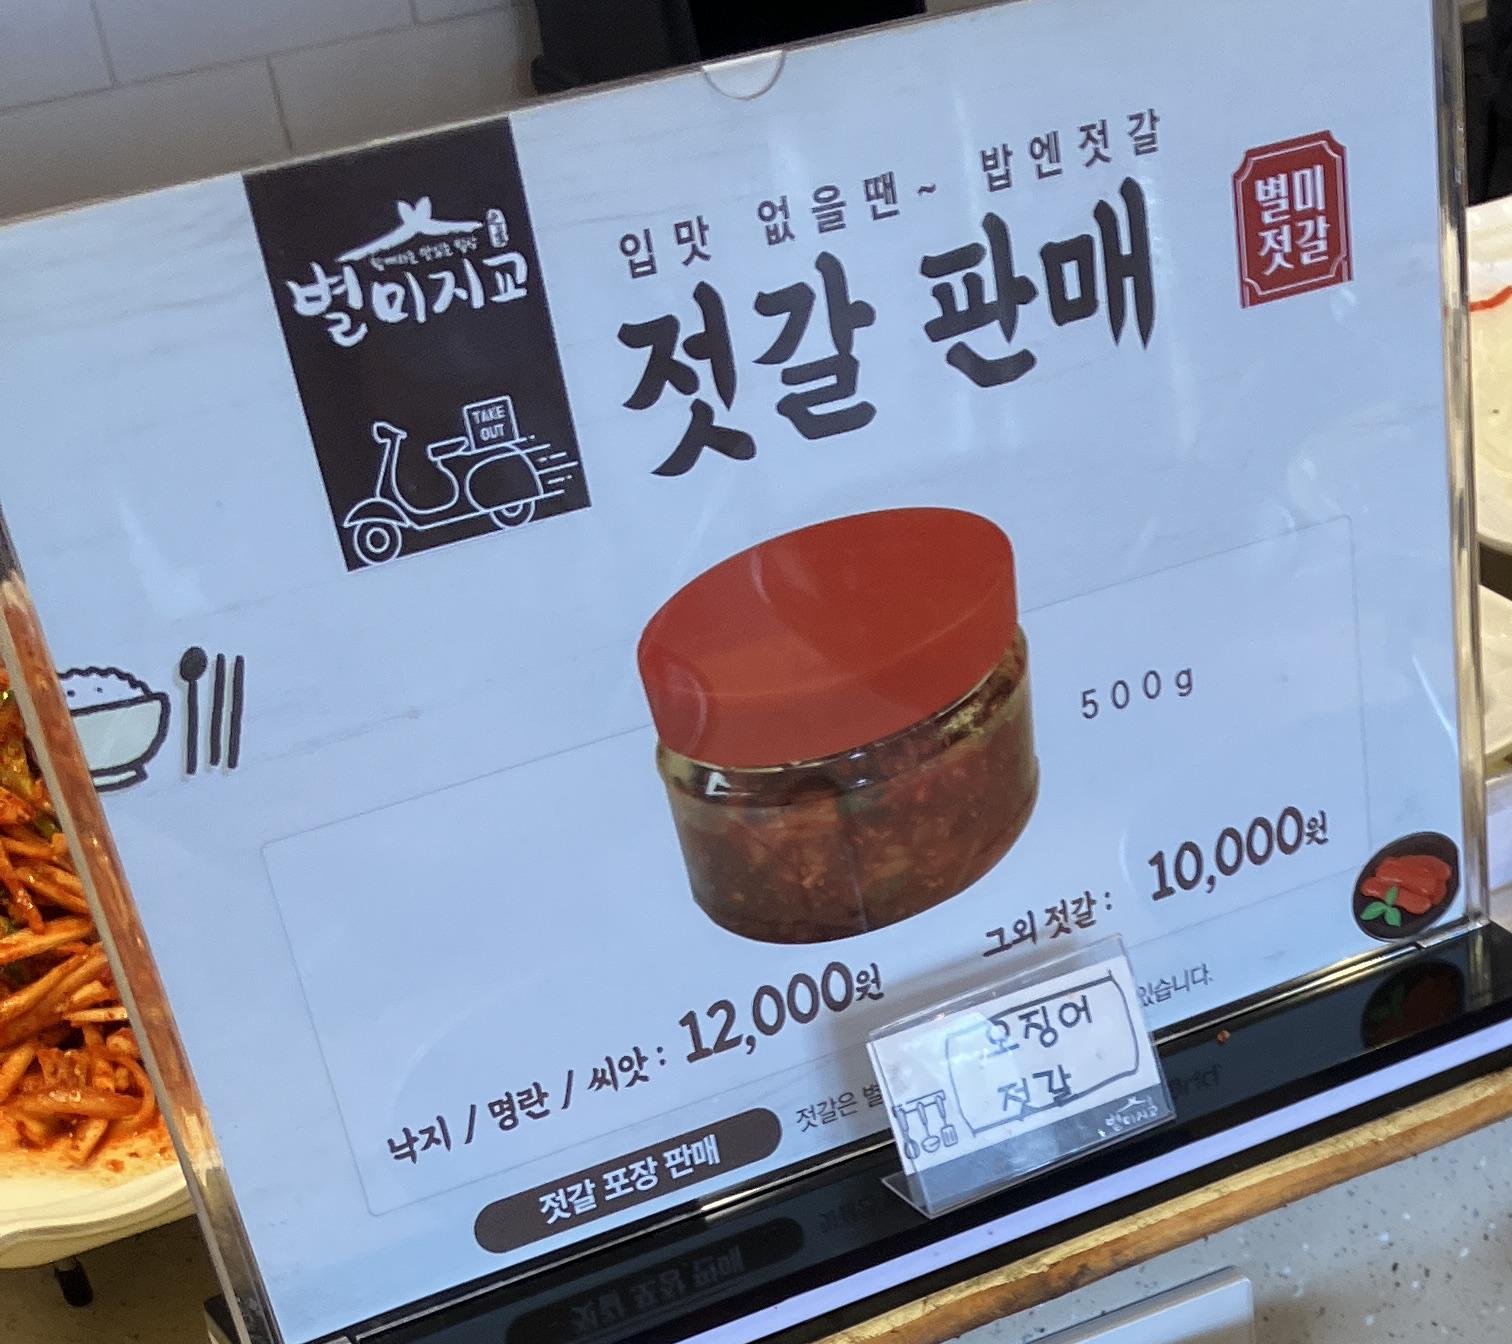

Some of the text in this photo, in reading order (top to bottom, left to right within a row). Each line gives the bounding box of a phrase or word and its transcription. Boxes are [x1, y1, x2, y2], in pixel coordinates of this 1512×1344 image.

[1255, 164, 1326, 225] 별미
[618, 216, 713, 279] 입맛
[1256, 216, 1332, 276] 젓갈
[286, 253, 528, 348] 별미지교
[617, 177, 1155, 477] 젓갈 판매
[472, 405, 506, 424] TAKE
[480, 423, 505, 441] OUT
[1081, 667, 1194, 719] 500g
[983, 911, 1039, 958] 그외
[1148, 807, 1330, 902] 10,000원
[987, 995, 1093, 1058] 오징어
[387, 1116, 452, 1165] 낙지
[488, 1081, 551, 1132] 명란
[679, 961, 885, 1063] 12,000원
[997, 1064, 1072, 1121] 젓갈
[796, 1091, 859, 1132] 젓갈은
[538, 1134, 721, 1226] 젓갈 포장 판매
